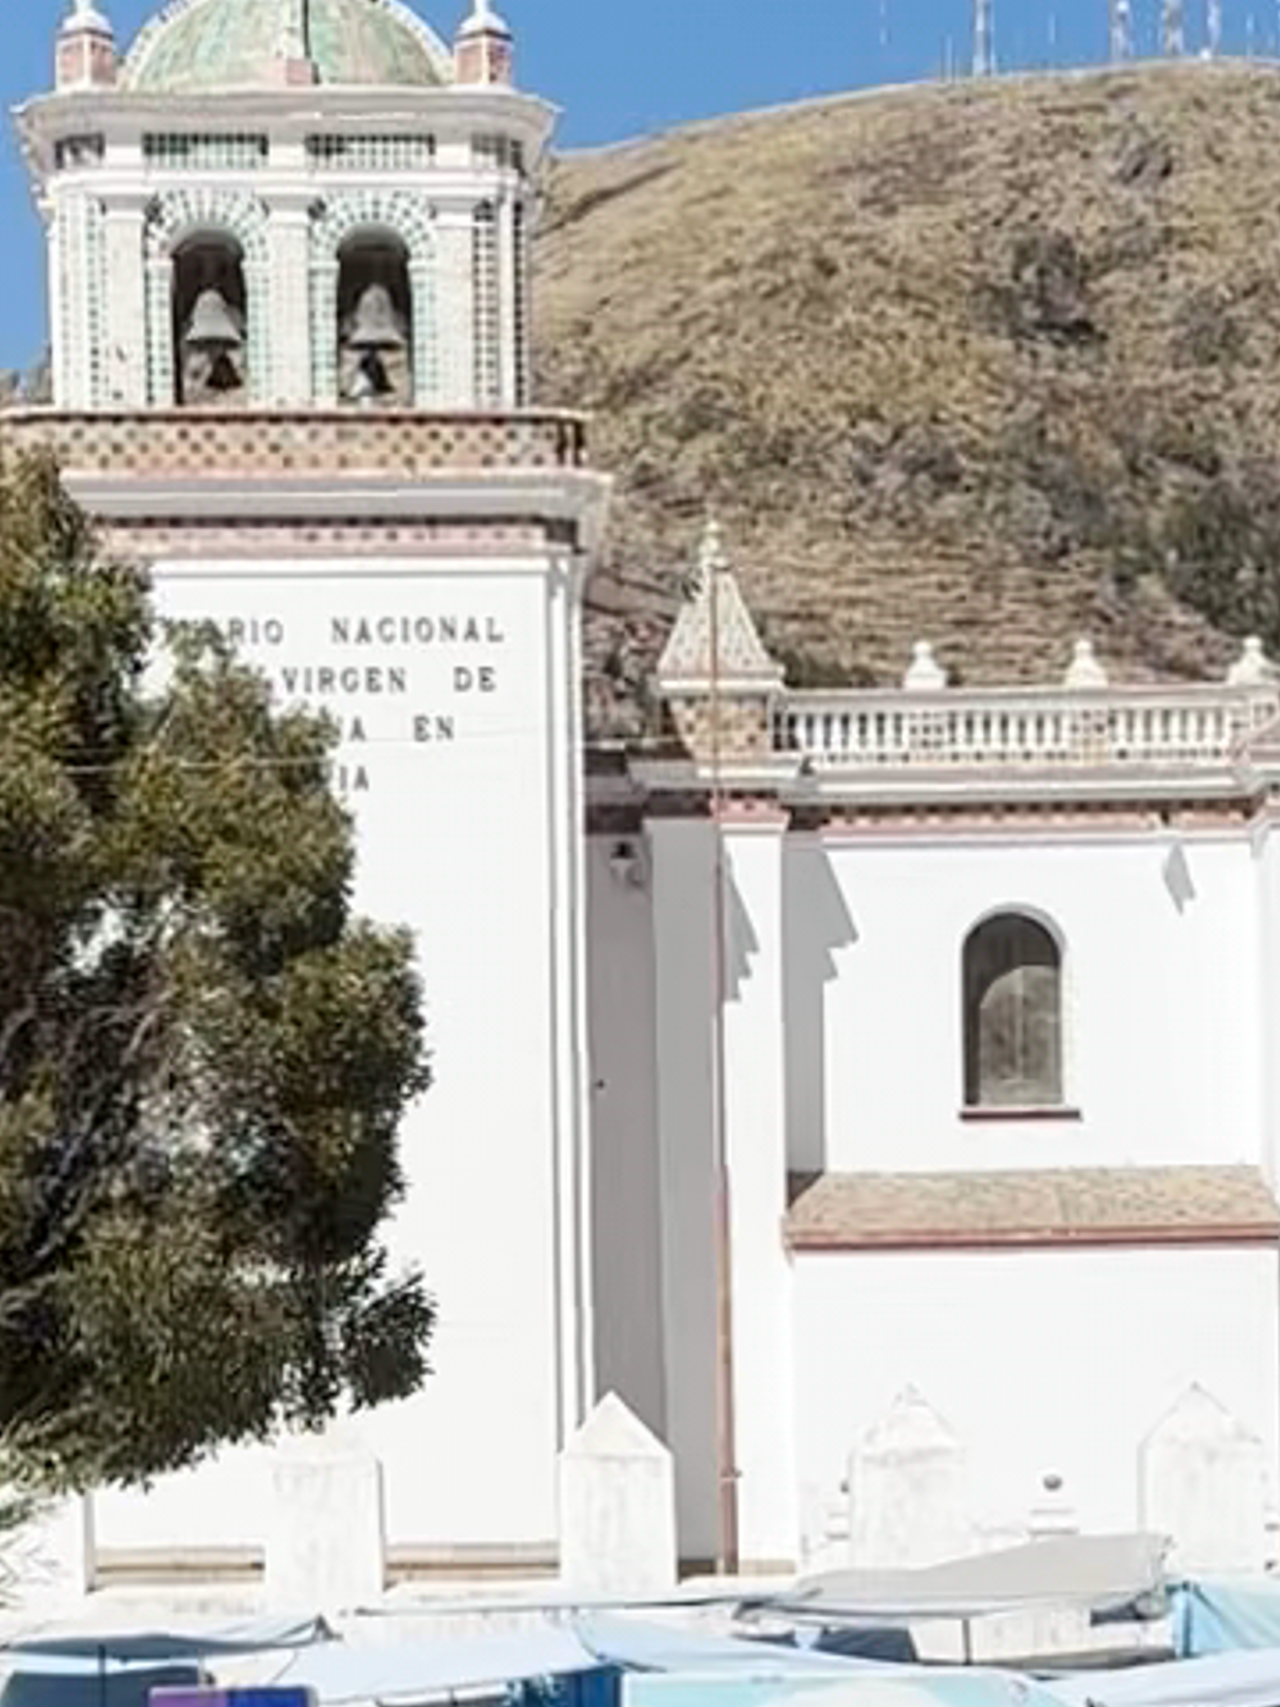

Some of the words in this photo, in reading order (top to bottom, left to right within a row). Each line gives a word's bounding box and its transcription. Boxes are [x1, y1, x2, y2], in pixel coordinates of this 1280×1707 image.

[331, 616, 505, 644] NACIONAL
[282, 665, 406, 694] VIRGEN
[453, 665, 496, 693] DE
[413, 714, 455, 742] EN
